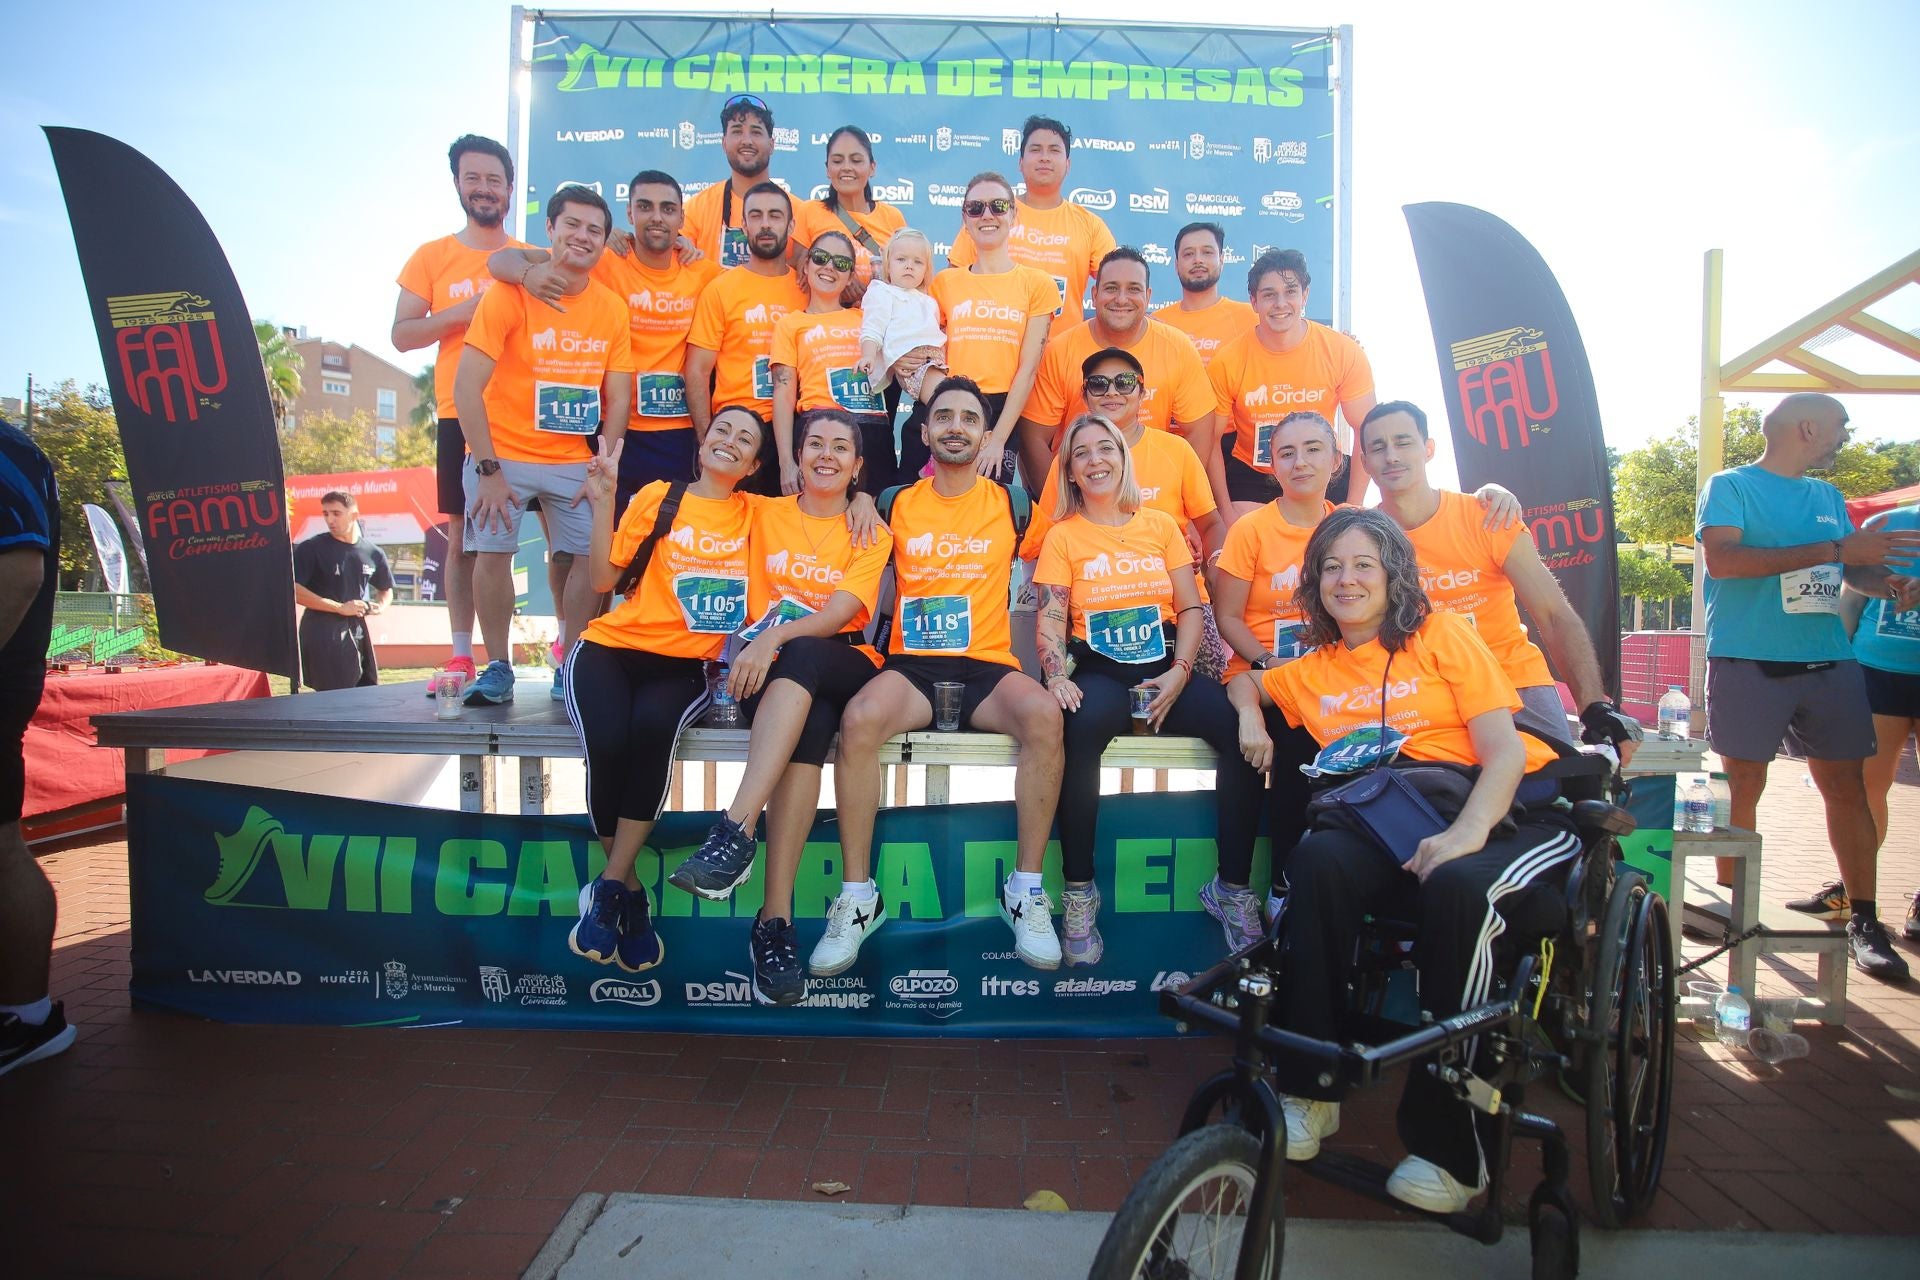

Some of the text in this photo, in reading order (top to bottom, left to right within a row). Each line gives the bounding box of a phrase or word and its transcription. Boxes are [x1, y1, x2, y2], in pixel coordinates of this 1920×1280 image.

[597, 53, 1305, 107] VII CARRERA DE EMPRESAS
[556, 128, 625, 143] LA VERDAD
[1082, 139, 1136, 152] VERDAD
[872, 186, 913, 200] DSM
[1076, 194, 1110, 205] VIDAL
[1130, 194, 1169, 210] DSM
[1027, 232, 1070, 246] Order
[124, 313, 204, 326] 1925 2025
[975, 304, 1026, 324] Order
[560, 336, 608, 352] Order
[1465, 345, 1538, 368] 1925 2025
[650, 388, 682, 401] 1103
[841, 382, 870, 396] 110
[1272, 387, 1326, 404] Order
[550, 400, 589, 418] 1117
[177, 483, 240, 498] ATLETISMO
[365, 480, 398, 495] Murcia
[148, 490, 280, 538] FAMU
[1522, 502, 1566, 518] LETISMO
[1530, 508, 1605, 550] MU
[168, 532, 272, 560] Corriendo
[1116, 554, 1164, 575] Orde
[790, 561, 844, 584] Orde
[1100, 582, 1136, 593] software
[1110, 590, 1144, 600] valorado
[690, 593, 736, 612] 1105
[814, 592, 830, 600] gest
[914, 613, 958, 631] 1118
[1102, 624, 1151, 644] 1110
[1347, 678, 1420, 710] Order
[1386, 710, 1418, 725] estión
[273, 834, 416, 914] VII
[187, 970, 302, 986] LA VERDAD
[320, 975, 370, 984] MURCIA
[411, 973, 468, 984] Ayuntamiento
[518, 976, 566, 988] murcia
[412, 983, 456, 992] de Murcia
[514, 986, 567, 995] ATLETISMO
[600, 986, 652, 999] VIDAL
[686, 982, 752, 1001] DSM
[982, 976, 1040, 996] itres
[1054, 978, 1137, 994] atalayas
[520, 996, 568, 1006] Corriendo
[936, 1001, 962, 1010] familia
